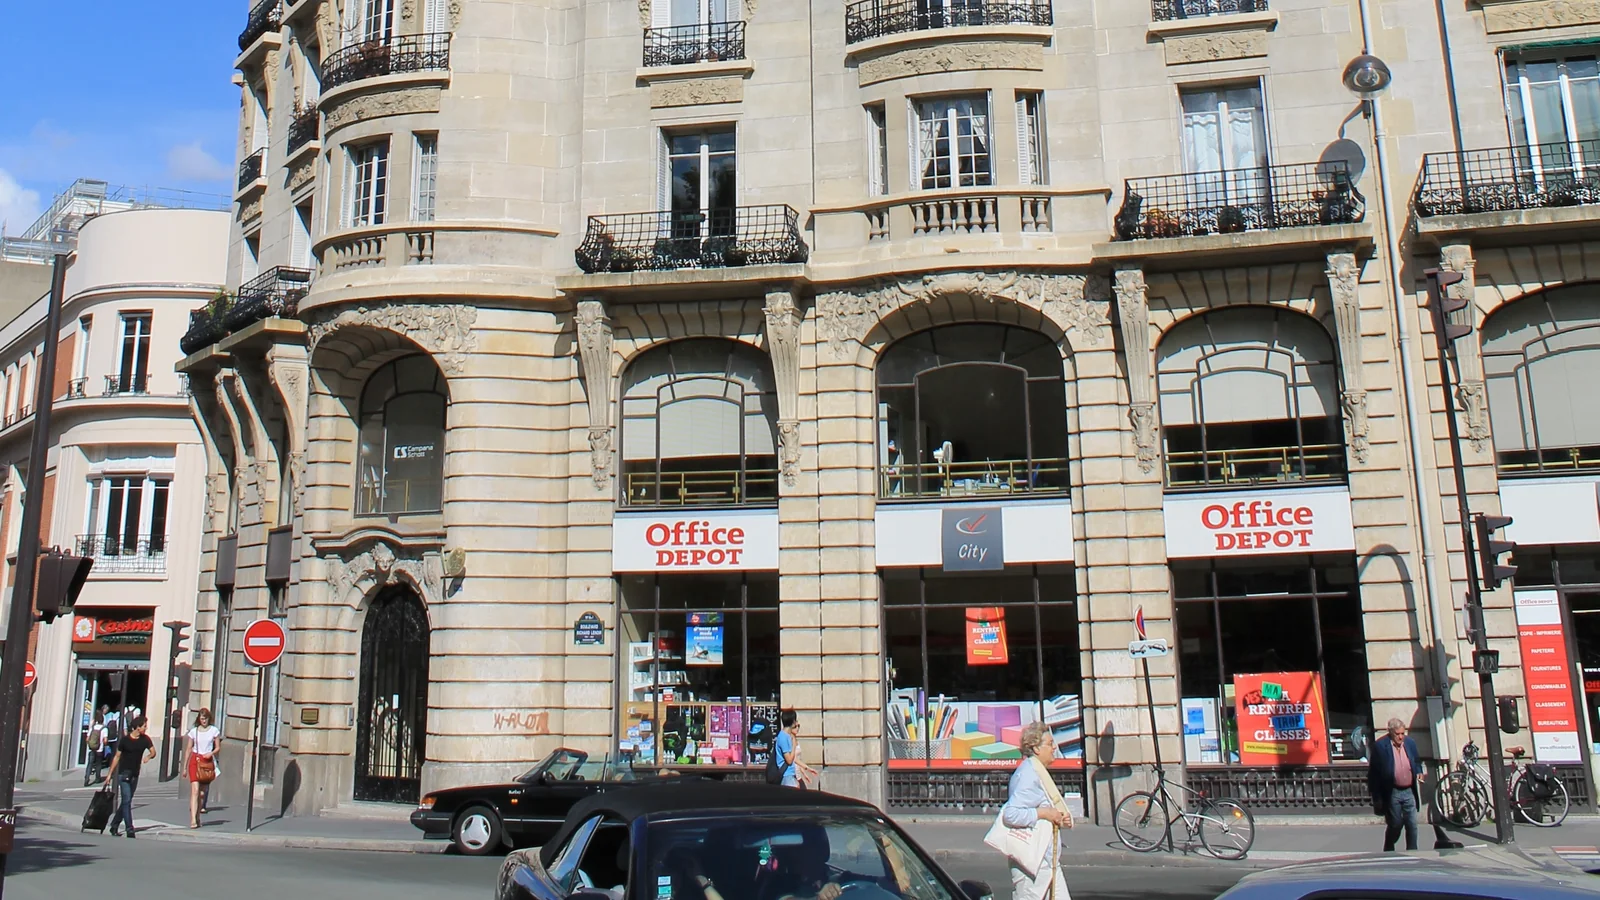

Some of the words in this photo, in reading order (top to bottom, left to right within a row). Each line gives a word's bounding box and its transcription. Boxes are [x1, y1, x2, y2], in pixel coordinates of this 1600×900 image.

[1201, 500, 1313, 530] Office
[645, 520, 745, 546] Office
[1214, 529, 1313, 550] DEPOT
[655, 548, 743, 566] DEPOT
[958, 543, 988, 562] City
[96, 618, 153, 634] Casino
[1248, 700, 1312, 715] RENTRÉE
[1278, 715, 1301, 728] TROP
